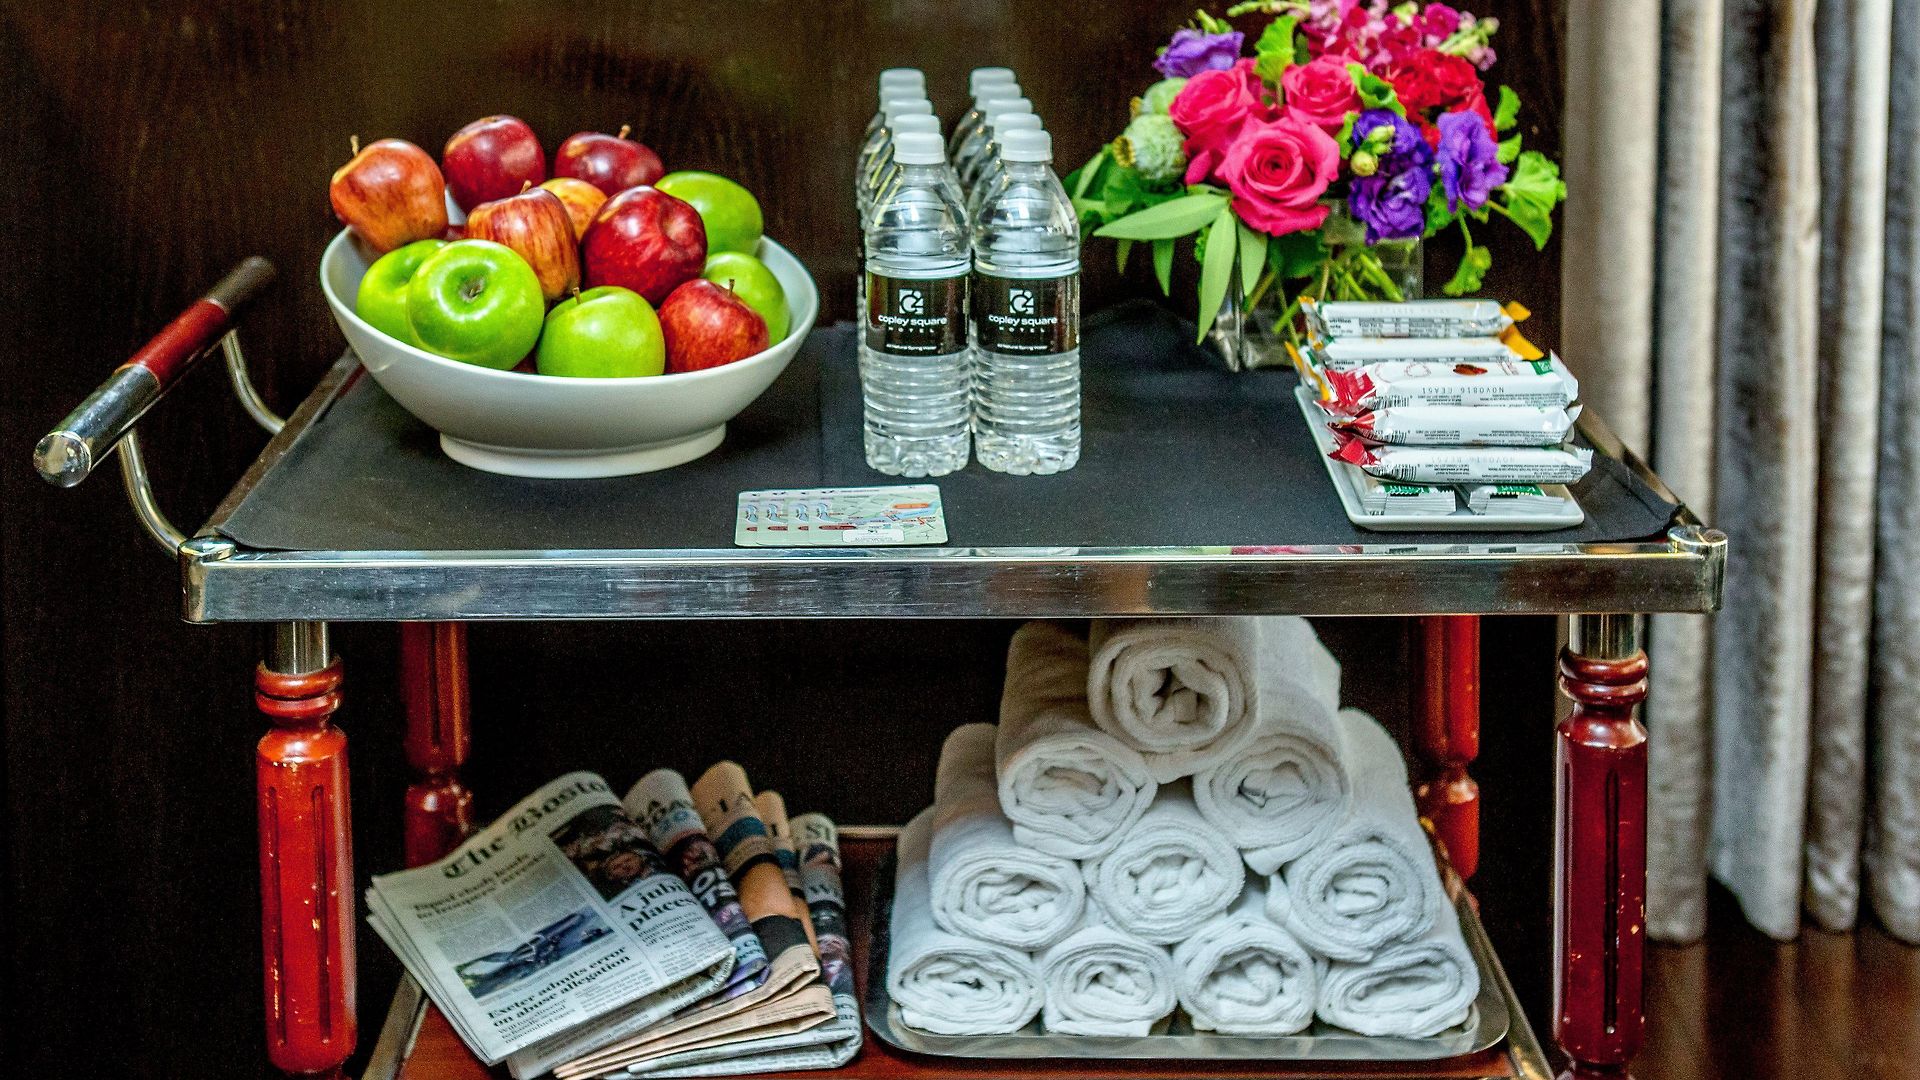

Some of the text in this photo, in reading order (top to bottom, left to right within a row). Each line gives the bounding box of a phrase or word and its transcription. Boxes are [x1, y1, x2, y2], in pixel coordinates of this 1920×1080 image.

[878, 314, 948, 328] copley square
[988, 314, 1058, 327] copley square
[443, 838, 504, 878] The
[620, 904, 638, 919] A
[488, 995, 535, 1018] Exeter
[538, 968, 588, 996] admits
[589, 946, 626, 969] error
[493, 1016, 513, 1027] on
[516, 993, 556, 1018] abuse
[560, 956, 631, 994] allegation
